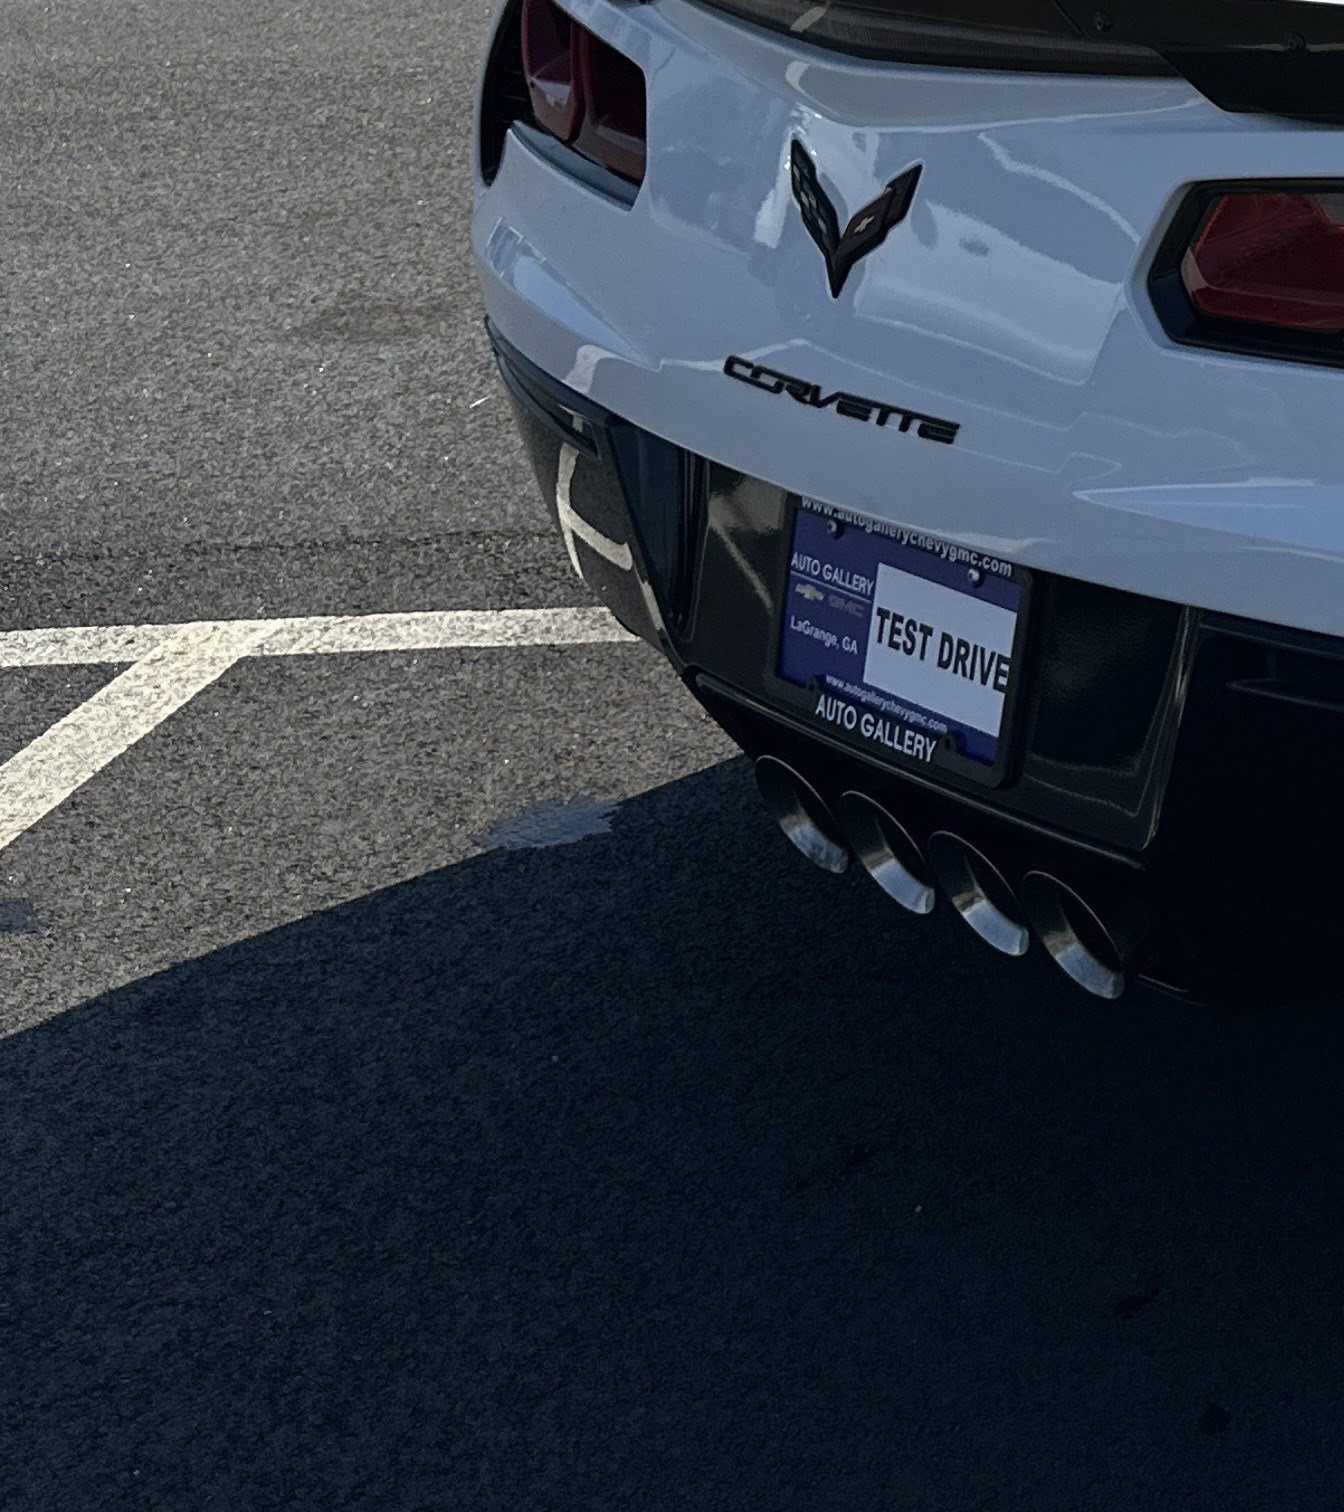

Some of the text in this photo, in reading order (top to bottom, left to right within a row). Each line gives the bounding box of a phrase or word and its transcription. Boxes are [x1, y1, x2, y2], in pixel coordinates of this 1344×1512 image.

[723, 354, 960, 444] CORVETTE
[790, 551, 874, 596] AUTO GALLERY
[790, 615, 858, 655] LaGrange, GA
[876, 606, 1011, 693] TEST DRIVE
[815, 694, 937, 763] AUTO GALLERY
